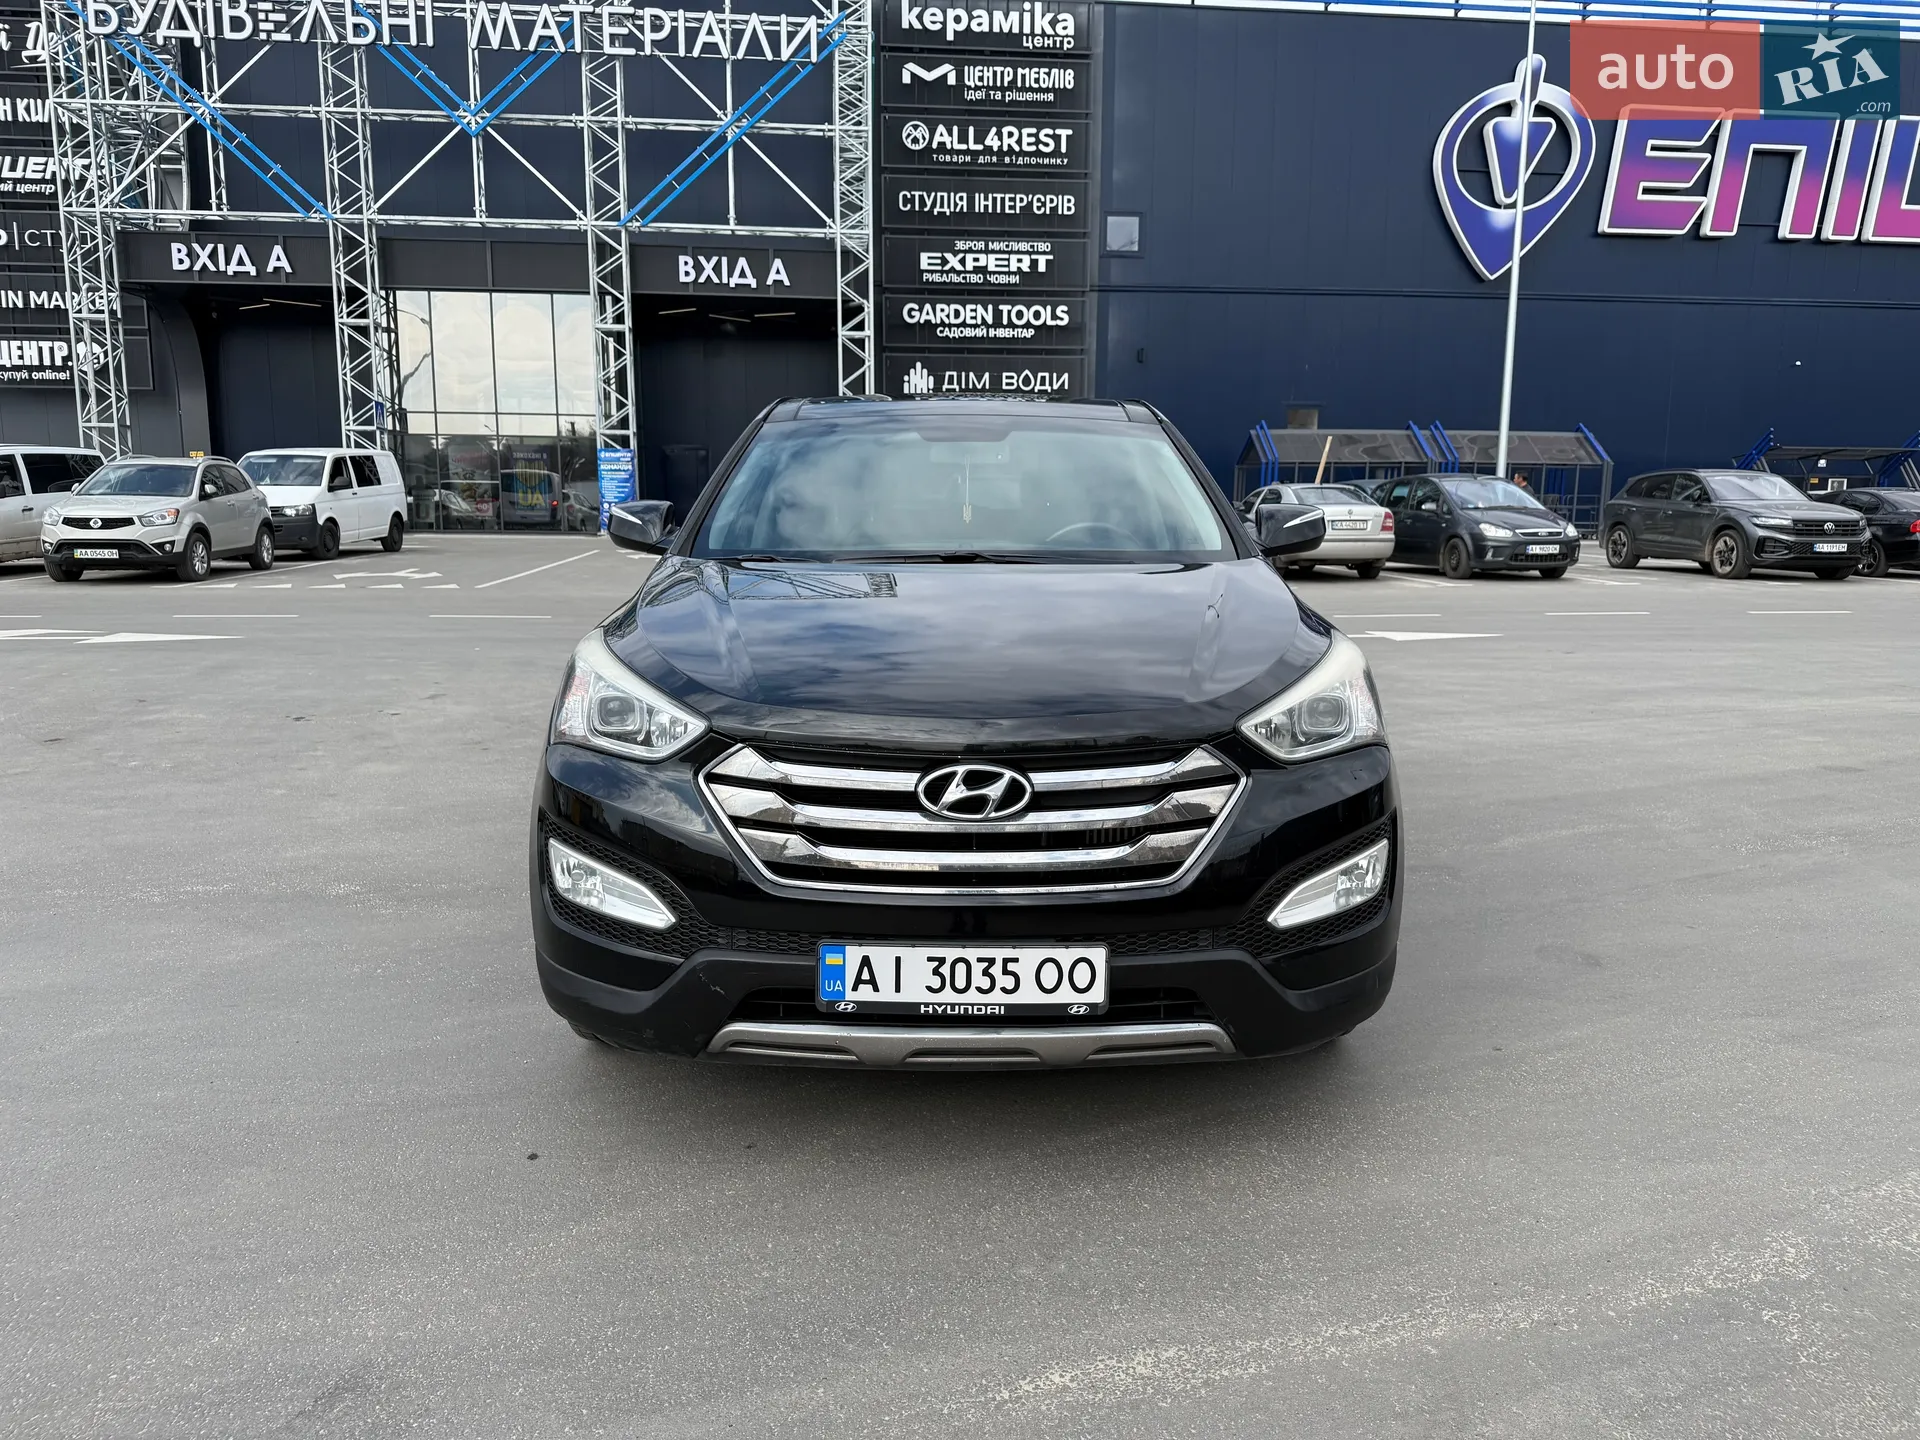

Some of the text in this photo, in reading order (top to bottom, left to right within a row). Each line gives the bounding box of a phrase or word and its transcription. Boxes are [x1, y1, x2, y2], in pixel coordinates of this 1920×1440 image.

[469, 0, 819, 64] МАТЕРІАЛИ
[1022, 35, 1075, 50] центр
[964, 65, 1075, 89] ЦЕНТР МЕБЛІВ
[964, 88, 1054, 103] ідеї та рішення
[931, 123, 1074, 153] ALL4REST
[932, 154, 971, 164] товари
[1004, 155, 1069, 166] відпочинку
[898, 191, 968, 216] СТУДІЯ
[954, 240, 1051, 252] ЗБРОЯ МИСЛИВСТВО
[170, 242, 293, 276] ВХІД А
[920, 252, 1054, 272] EXPERT
[678, 254, 791, 289] ВХІД А
[923, 272, 1020, 284] РИБАЛЬСТВО ЧОВНИ
[902, 302, 1070, 326] GARDEN TOOLS
[936, 325, 1035, 339] САДОВИЙ ІНВЕНТАР
[31, 369, 71, 381] online!
[942, 371, 990, 391] ДІМ
[851, 954, 901, 993] AI
[925, 956, 1021, 995] 3035
[825, 980, 843, 992] UA
[920, 1004, 1005, 1015] HYUNDAI
